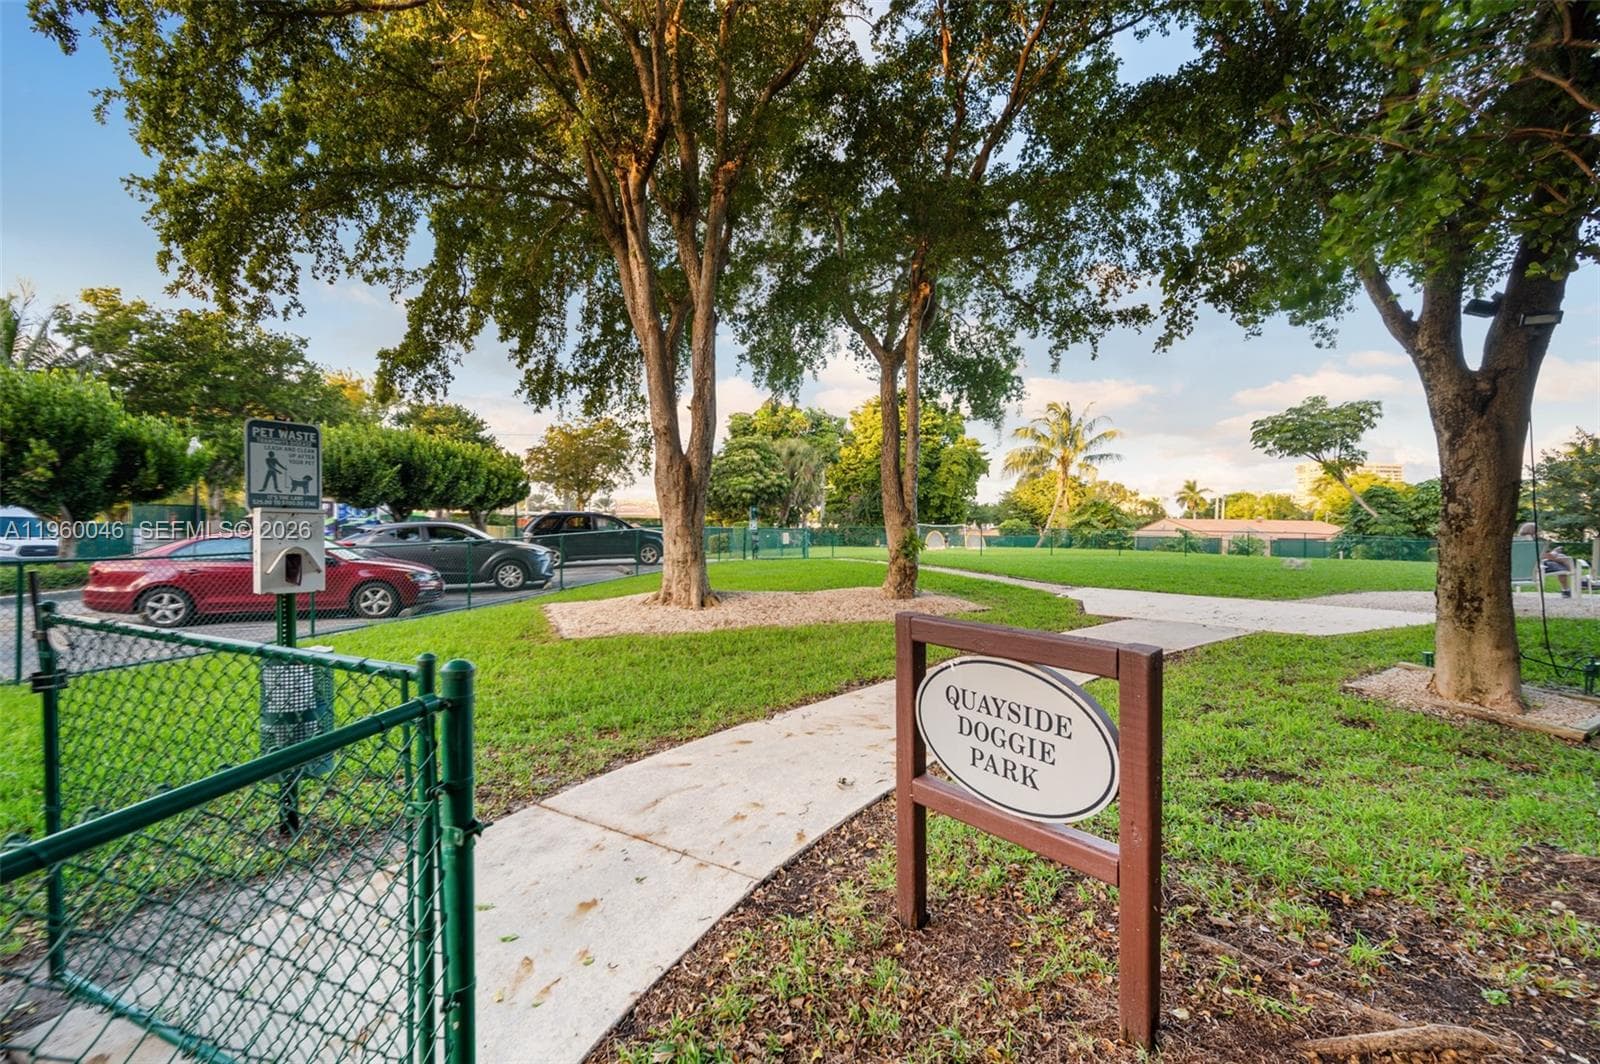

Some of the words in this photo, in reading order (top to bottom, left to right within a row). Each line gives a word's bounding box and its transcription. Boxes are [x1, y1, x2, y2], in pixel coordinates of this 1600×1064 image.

[252, 426, 275, 438] PET
[278, 429, 317, 442] WASTE
[945, 684, 1073, 740] QUAYSIDE
[958, 714, 1056, 766] DOGGIE
[970, 746, 1040, 791] PARK
